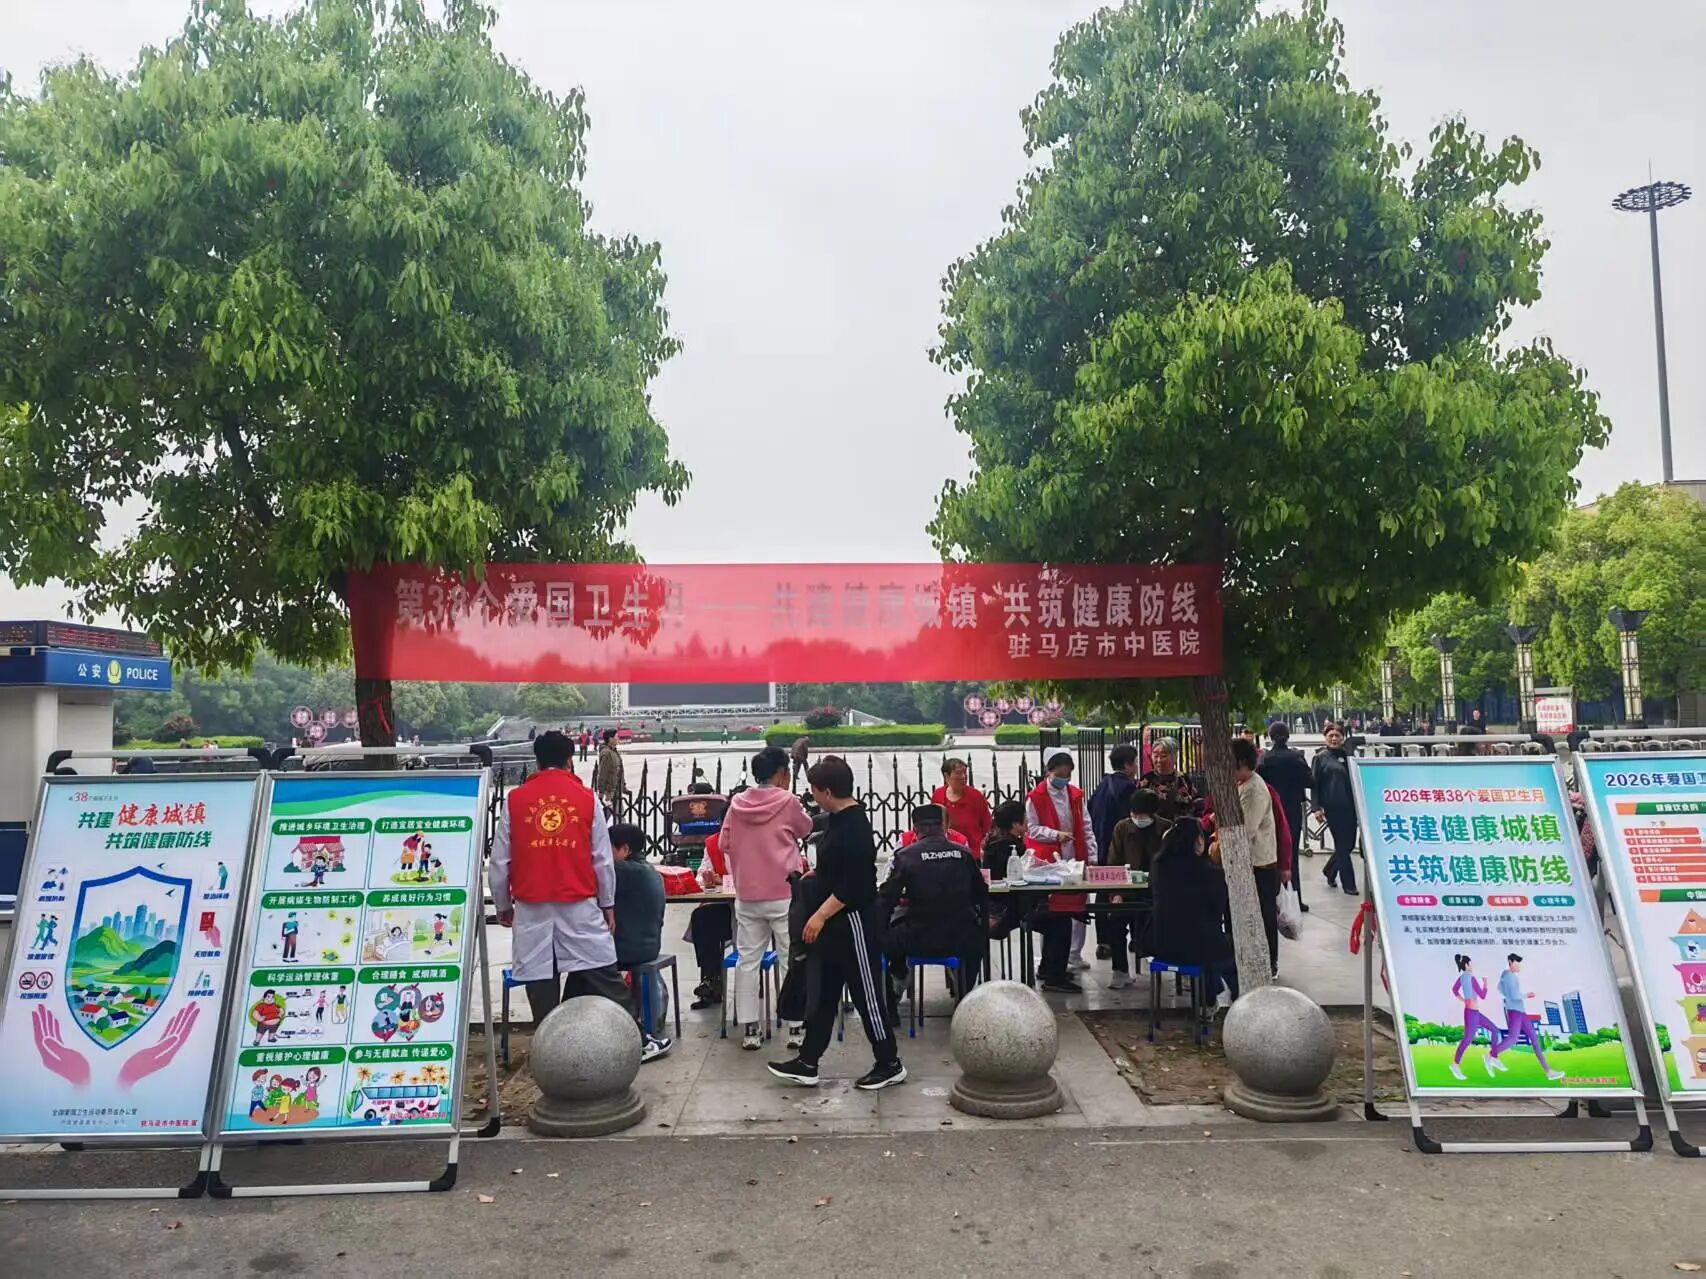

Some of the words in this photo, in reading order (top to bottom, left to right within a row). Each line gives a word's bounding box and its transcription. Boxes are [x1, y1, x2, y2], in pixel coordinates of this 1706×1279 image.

[1003, 581, 1200, 629] 共筑健康防线
[1007, 628, 1200, 659] 驻马店市中医院
[78, 663, 102, 679] 公安
[126, 667, 158, 680] POLICE
[1384, 788, 1546, 804] 2026年第38个爱国卫生月
[78, 811, 114, 829] 共建
[117, 802, 207, 826] 健康城镇
[278, 821, 366, 832] 推进城乡环境卫生治理
[381, 819, 466, 830] 打造宜居宜业健康环境
[1381, 814, 1561, 843] 共建健康城镇
[104, 831, 213, 850] 共筑健康防线
[1388, 854, 1572, 884] 共筑健康防线
[268, 894, 357, 905] 开展病媒生物防制工作
[382, 892, 451, 903] 养成良好行为习惯
[267, 971, 340, 983] 科学运动管理体重
[371, 970, 407, 981] 合理膳食
[411, 968, 448, 979] 戒烟限酒
[255, 1051, 330, 1063] 重视维护心理健康
[354, 1049, 409, 1060] 参与无偿献血
[411, 1048, 448, 1058] 传递爱心
